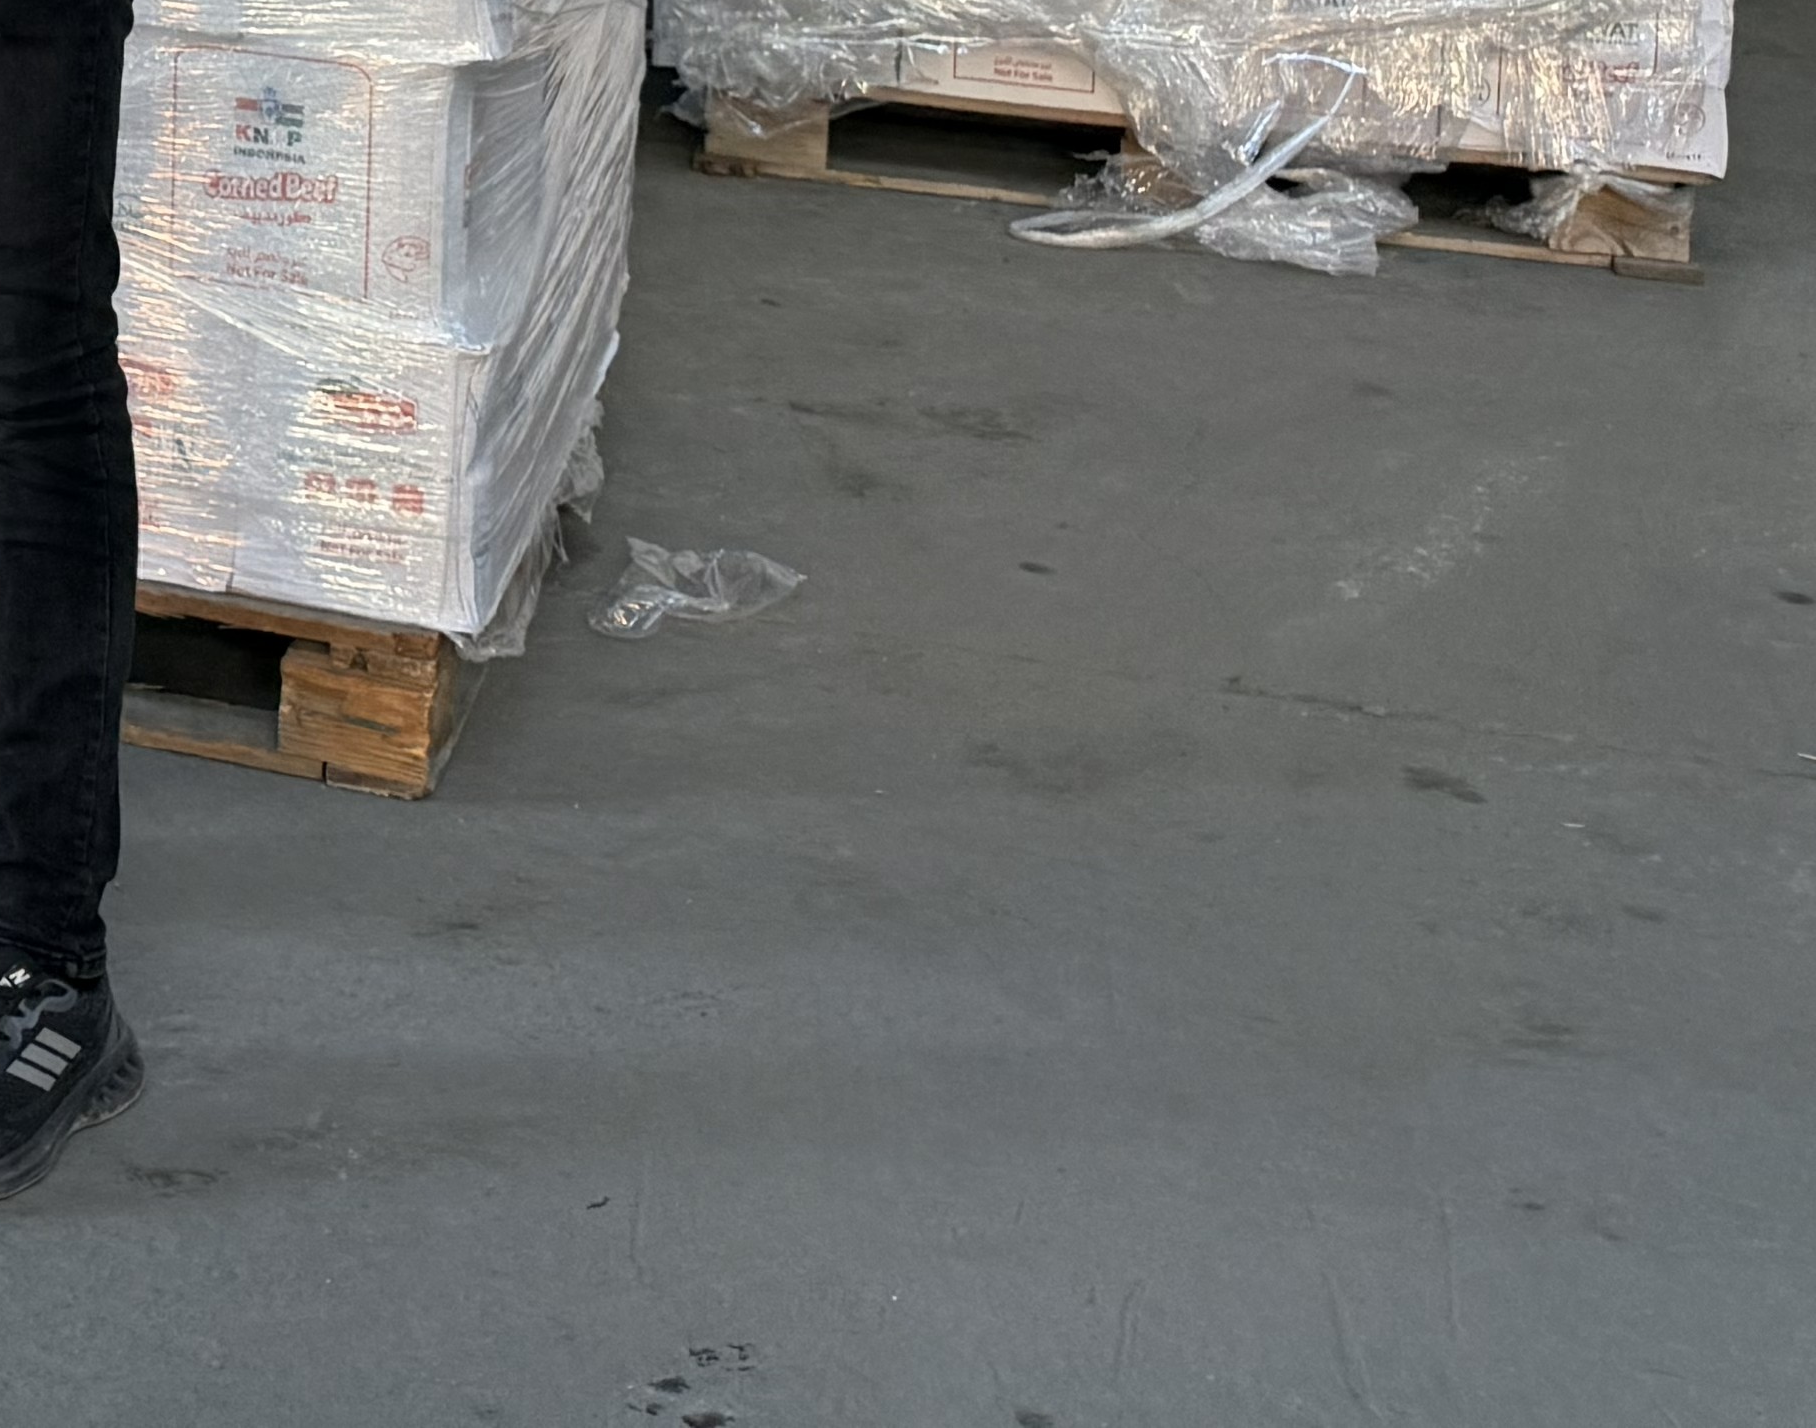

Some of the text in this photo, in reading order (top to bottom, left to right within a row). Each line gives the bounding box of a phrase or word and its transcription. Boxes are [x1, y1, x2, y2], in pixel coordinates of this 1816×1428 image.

[235, 124, 302, 147] KNP
[203, 169, 339, 204] Corned Beef
